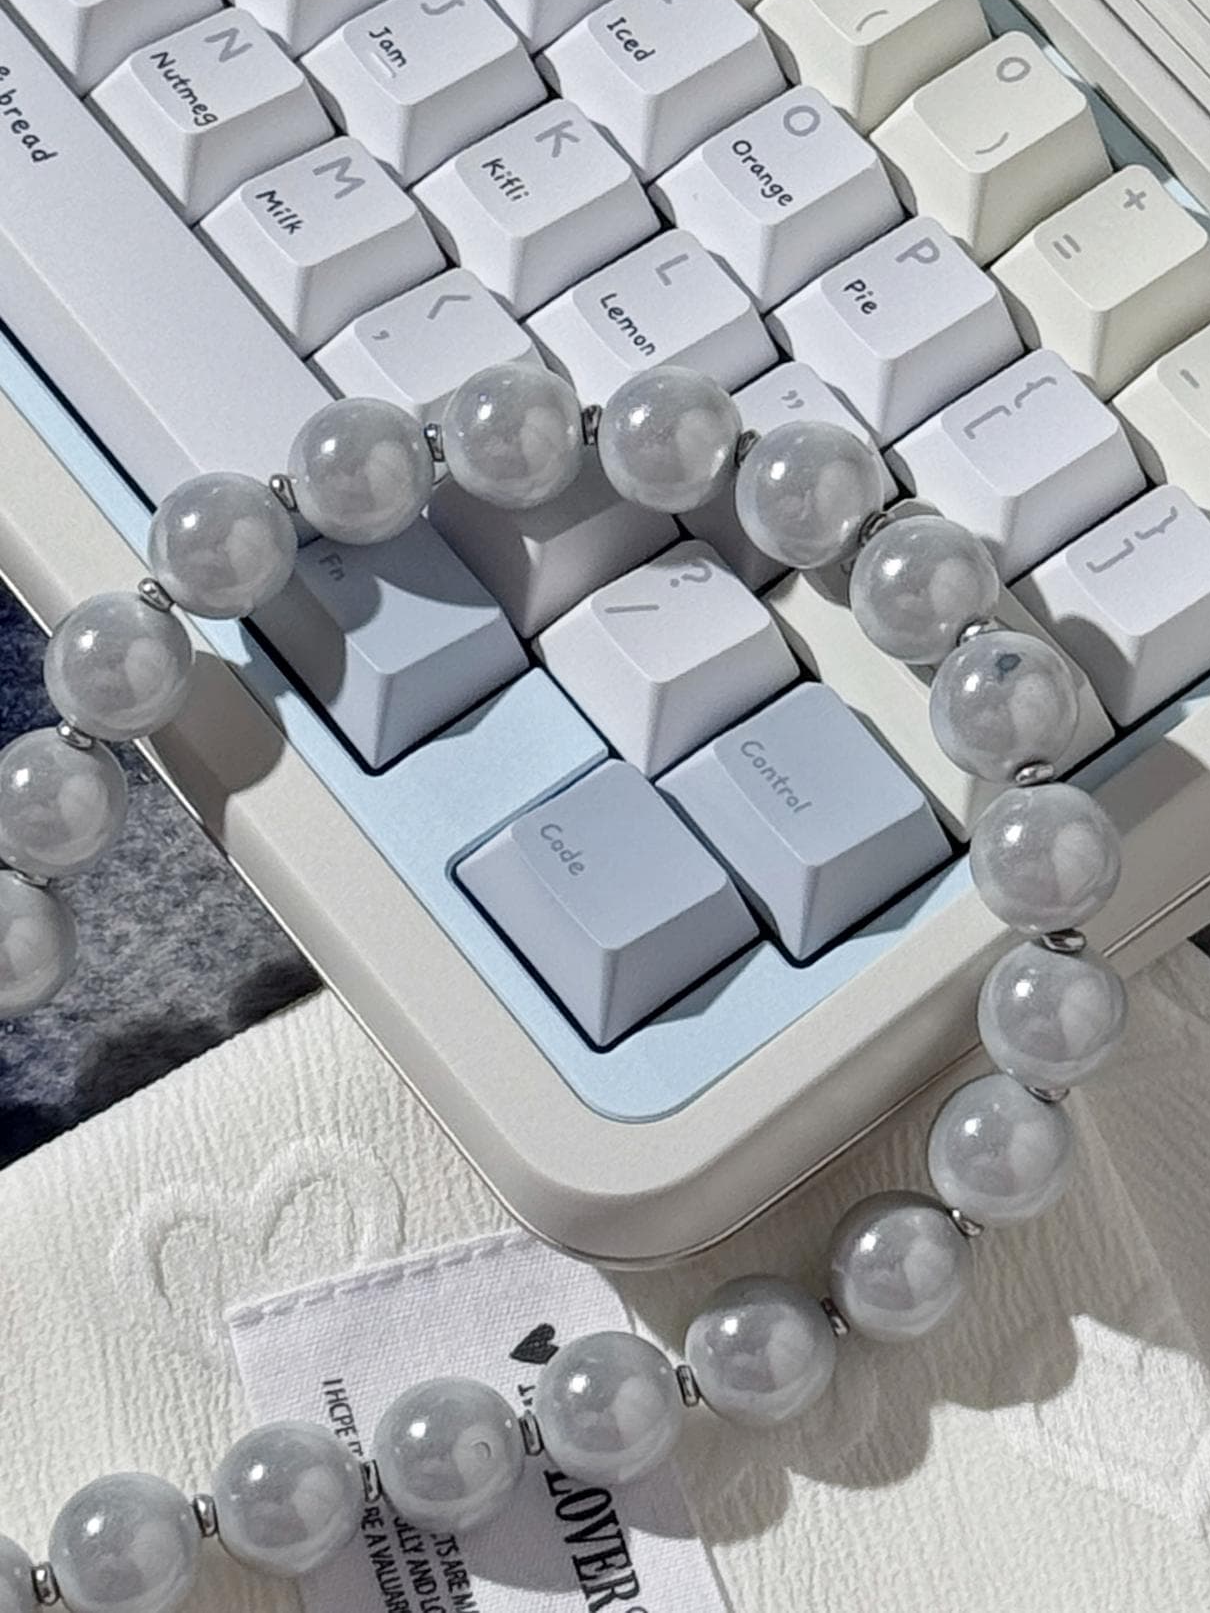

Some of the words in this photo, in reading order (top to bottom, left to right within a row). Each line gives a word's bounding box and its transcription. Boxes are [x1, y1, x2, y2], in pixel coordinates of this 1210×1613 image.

[203, 27, 253, 63] N
[369, 26, 408, 67] Jam
[606, 16, 656, 63] Iced
[149, 51, 219, 128] Nutmeg
[534, 120, 581, 159] K
[313, 156, 366, 201] M
[481, 157, 530, 203] Kifli
[732, 139, 794, 207] Orange
[255, 189, 305, 236] Milk
[654, 253, 689, 287] L
[895, 237, 940, 264] P
[843, 278, 878, 315] Pie
[600, 292, 657, 357] Lemon
[318, 552, 346, 582] Fn
[740, 740, 812, 815] Control
[539, 823, 585, 876] Code
[545, 1467, 650, 1613] LOVER
[406, 1558, 437, 1596] AND
[441, 1559, 471, 1592] ARE
